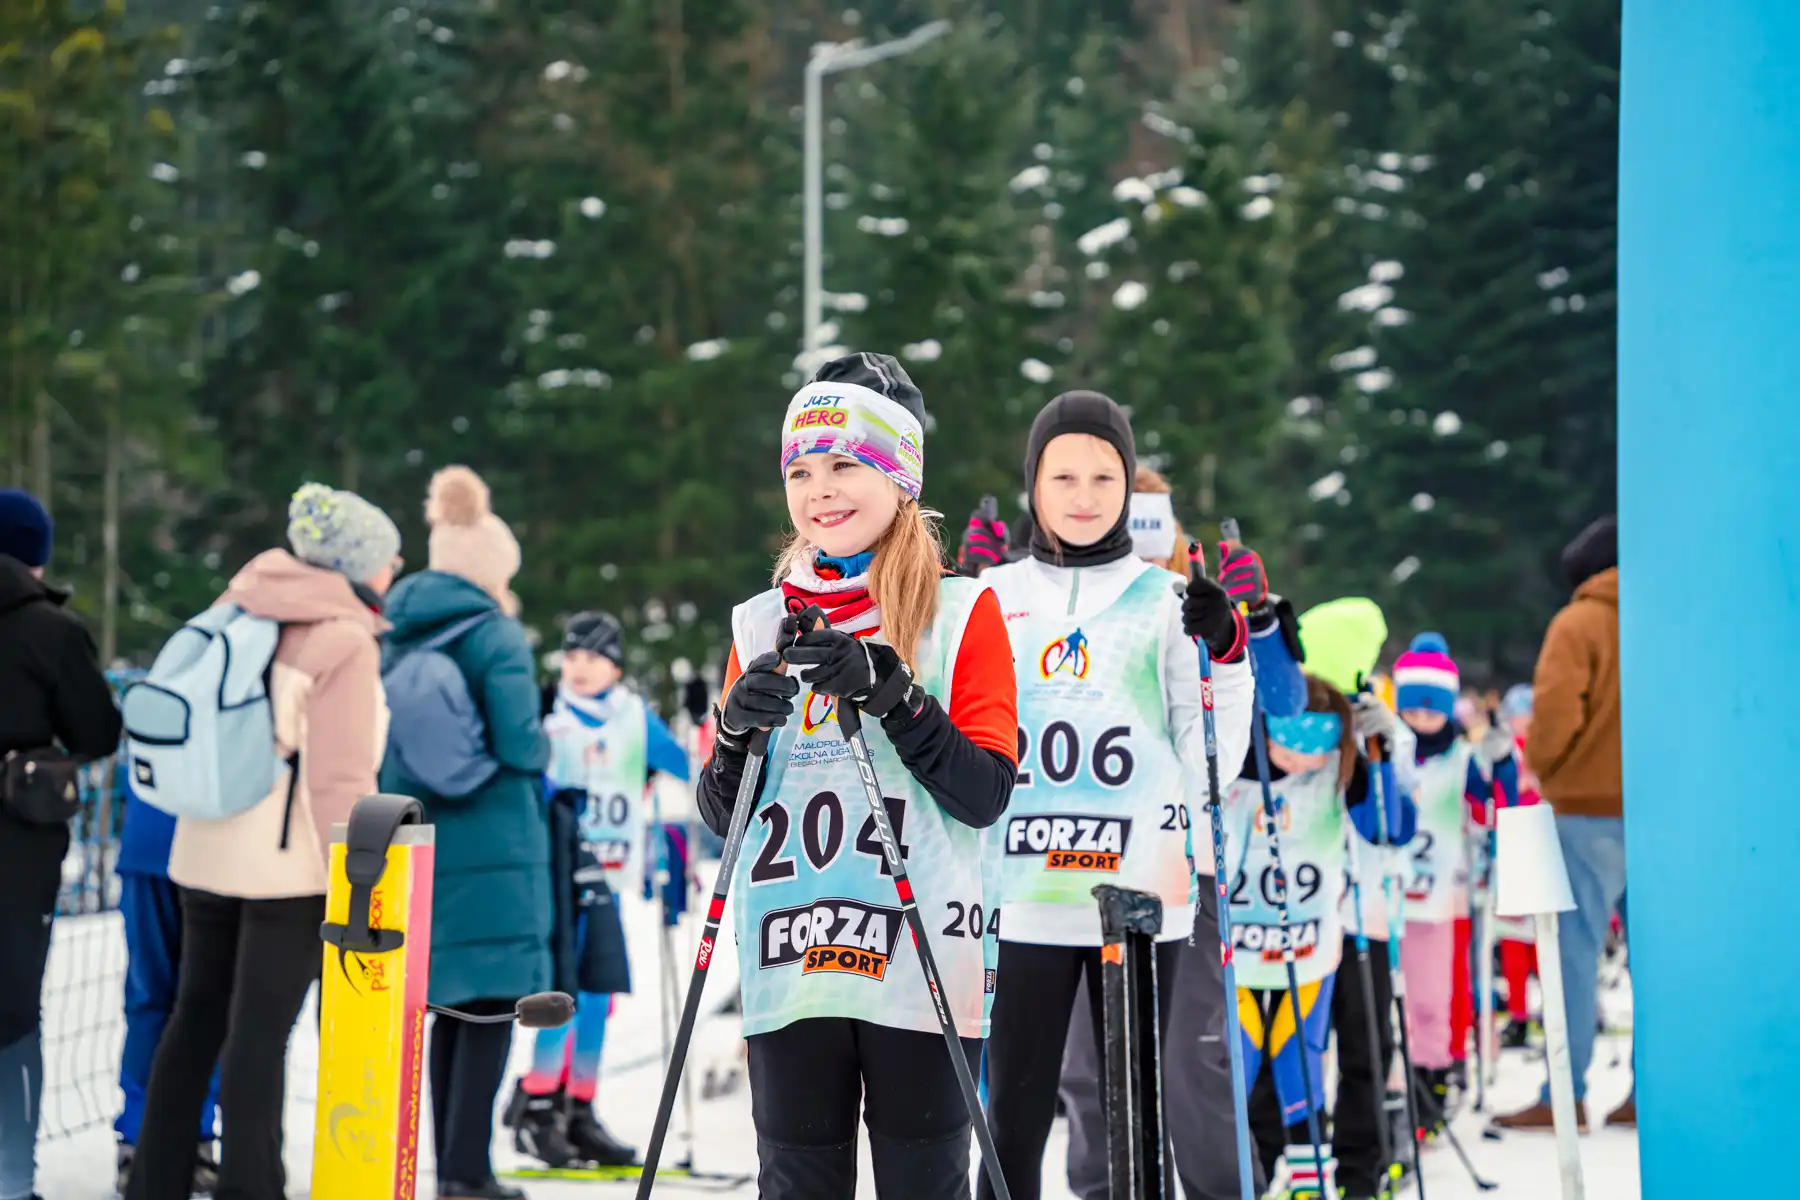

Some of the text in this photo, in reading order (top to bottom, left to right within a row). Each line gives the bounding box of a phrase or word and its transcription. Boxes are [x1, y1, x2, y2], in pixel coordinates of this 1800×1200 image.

[803, 395, 845, 409] JUST
[795, 410, 846, 428] HERO
[788, 750, 828, 761] ZKOLNA
[751, 791, 909, 883] 204
[1008, 818, 1122, 852] FORZA
[1050, 853, 1117, 870] SPORT
[1230, 863, 1322, 906] 209
[768, 906, 888, 960] FORZA
[942, 900, 1000, 943] 204
[806, 949, 883, 976] SPORT
